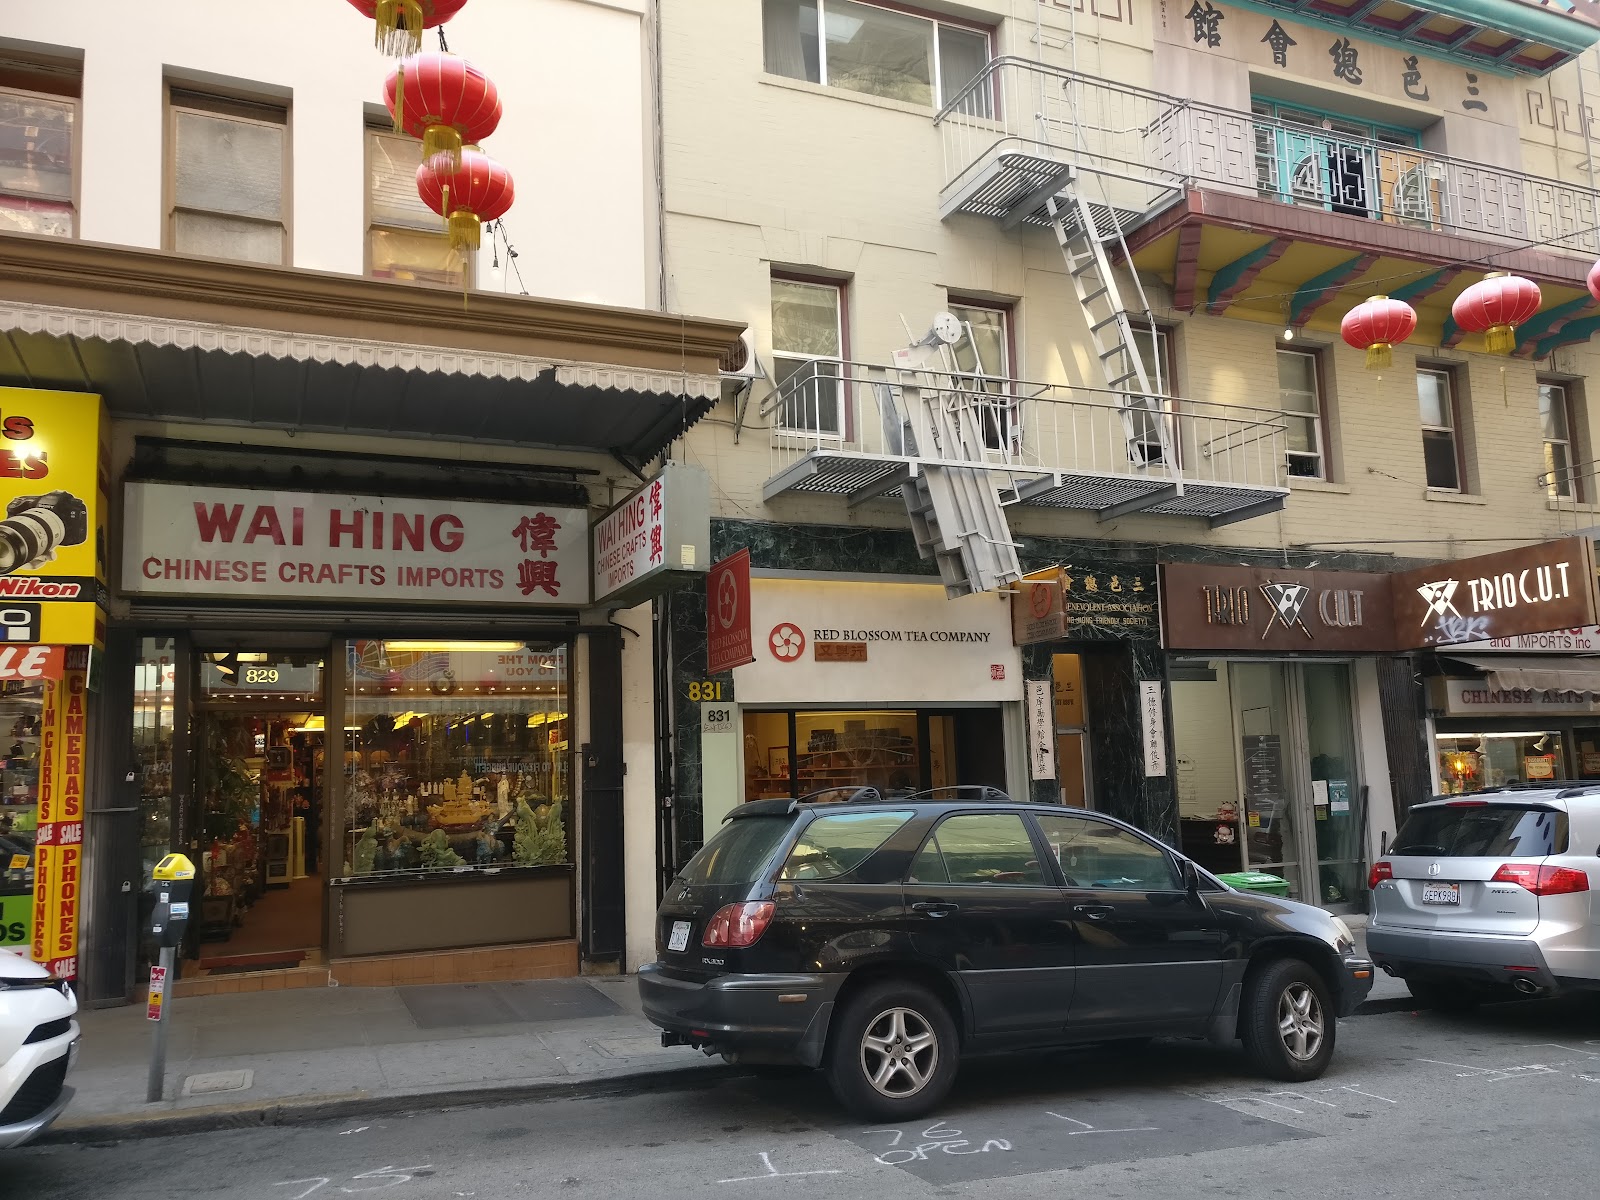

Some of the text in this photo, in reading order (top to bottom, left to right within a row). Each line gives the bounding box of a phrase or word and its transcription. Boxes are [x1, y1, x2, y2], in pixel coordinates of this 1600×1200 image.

[193, 502, 464, 552] WAI HING
[597, 496, 645, 554] WAI HING
[597, 549, 621, 576] CHINESE
[621, 530, 647, 560] CRAFTS
[142, 556, 504, 589] CHINESE CRAFTS IMPORTS
[607, 560, 634, 589] IMPORTS
[0, 578, 80, 597] Nikon
[1468, 572, 1517, 613] TRIO
[1202, 585, 1249, 625] TRIO
[722, 628, 748, 647] BLOSSOM
[813, 629, 991, 643] RED BLOSSOM TEA COMPANY
[1517, 635, 1572, 648] IMPORTS
[67, 650, 87, 668] SALE
[721, 643, 748, 662] COMPANY
[246, 669, 279, 683] 829
[688, 681, 721, 701] 831
[1461, 689, 1533, 704] CHINESE
[1542, 690, 1584, 704] ARTS
[708, 709, 730, 722] 831
[41, 680, 56, 820] SIM CARDS
[64, 675, 84, 816] CAMERAS
[37, 823, 53, 845] SALE
[60, 823, 82, 845] SALE
[34, 848, 48, 958] PHONES
[59, 849, 77, 952] PHONES
[54, 957, 76, 979] SALE
[874, 1138, 1012, 1165] OPEN
